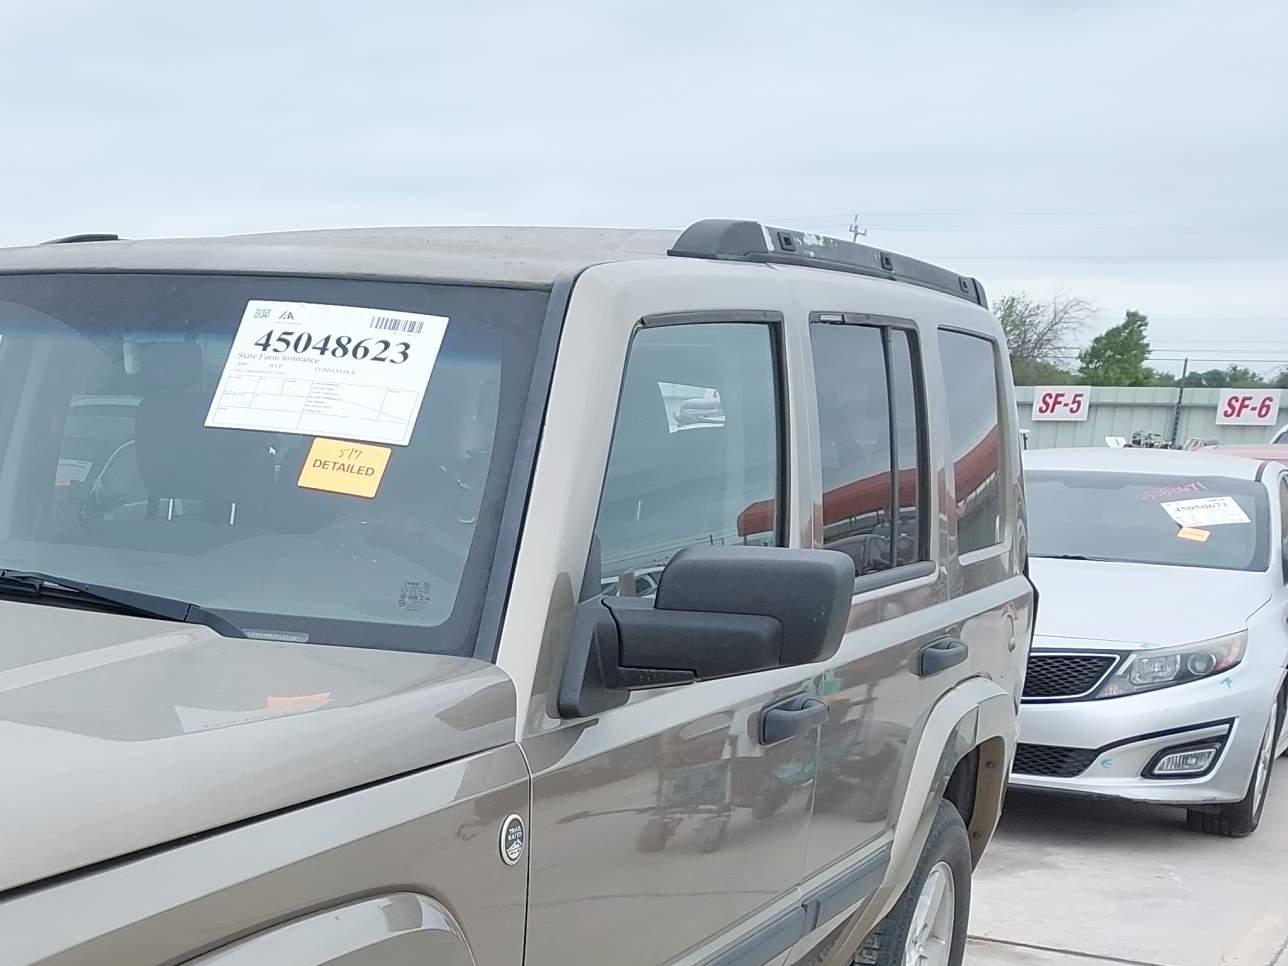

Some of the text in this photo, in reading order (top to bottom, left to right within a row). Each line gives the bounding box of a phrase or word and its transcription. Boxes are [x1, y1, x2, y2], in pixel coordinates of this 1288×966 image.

[253, 329, 412, 365] 45048623
[1038, 392, 1085, 415] SF-5
[1223, 395, 1274, 418] SF-6
[311, 458, 376, 477] DETAILED
